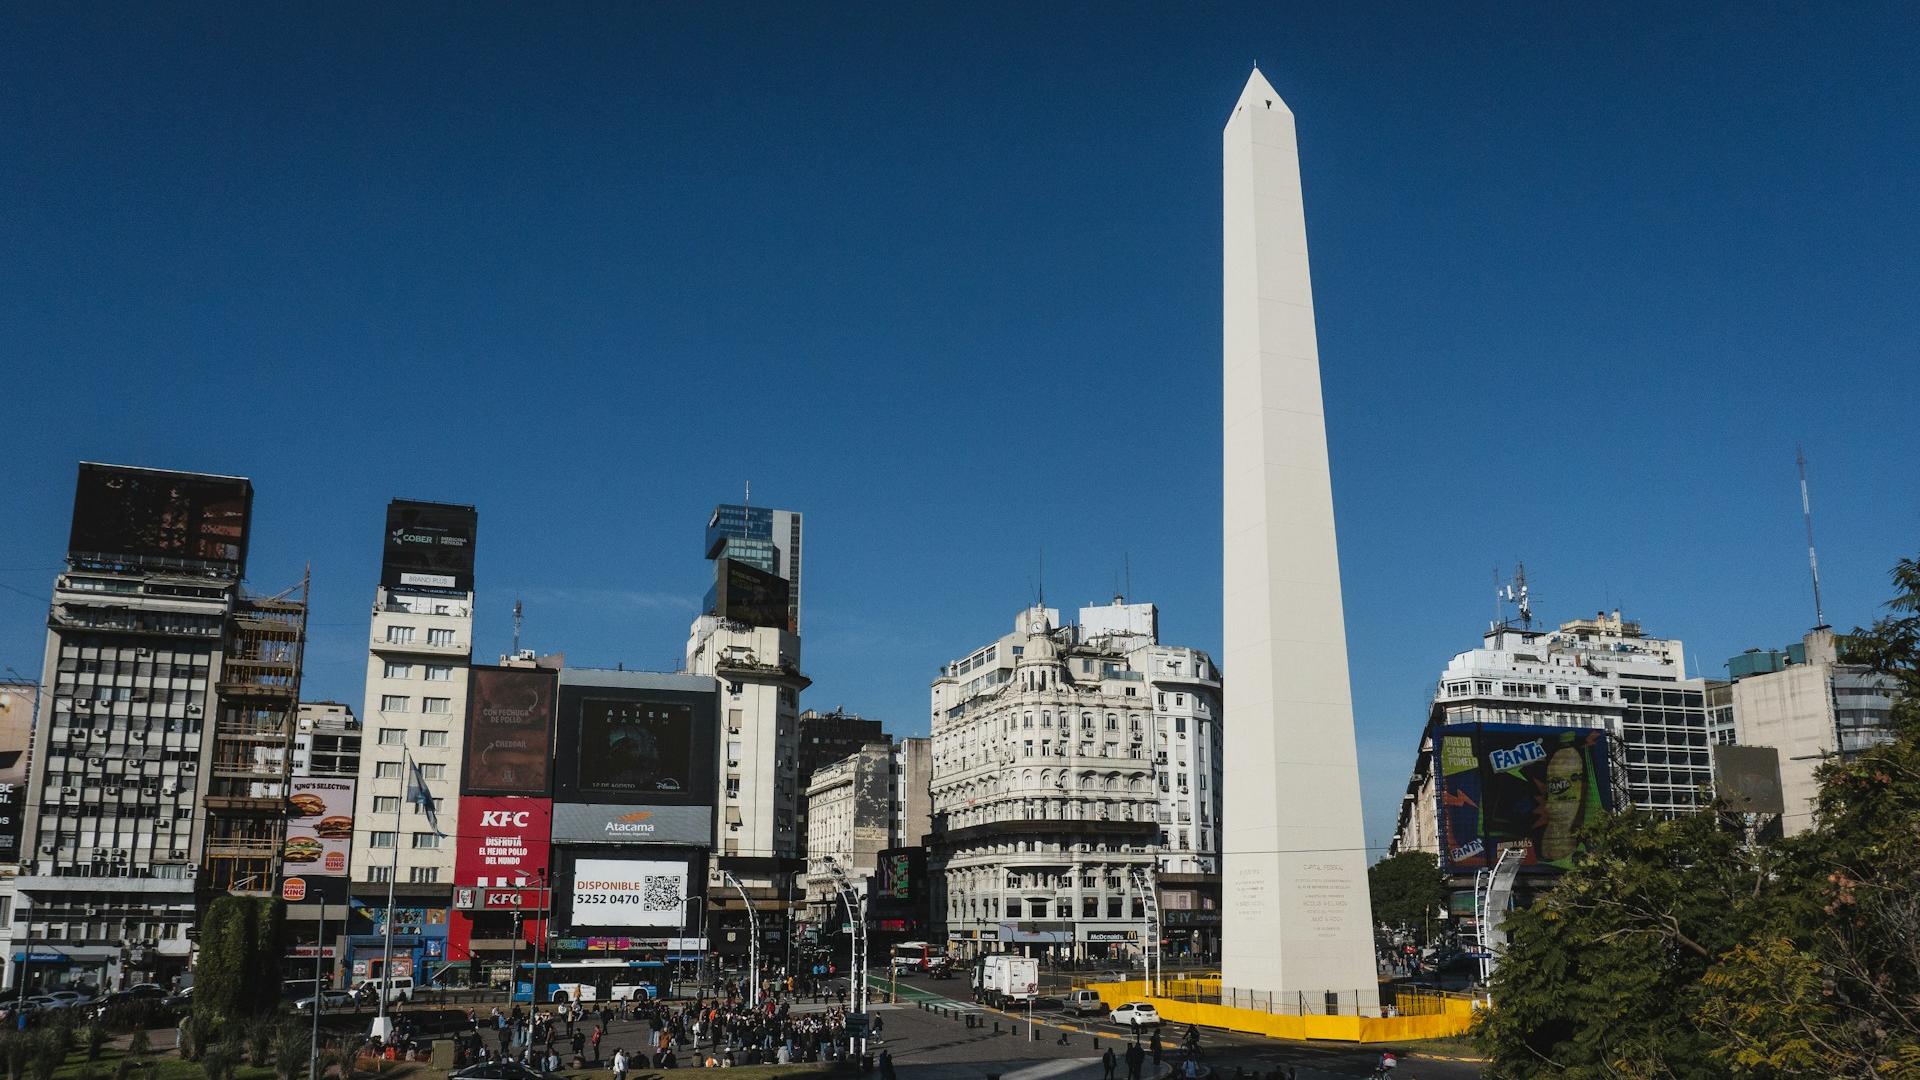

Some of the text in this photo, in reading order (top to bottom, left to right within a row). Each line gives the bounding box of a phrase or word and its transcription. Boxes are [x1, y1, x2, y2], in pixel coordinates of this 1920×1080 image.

[402, 534, 432, 544] COBER
[607, 709, 668, 718] ALIEN
[1444, 736, 1471, 746] NUEVO
[1447, 746, 1472, 756] SABOR
[1493, 742, 1544, 770] FANTA
[1448, 756, 1478, 767] POMELO
[480, 811, 530, 827] KFC
[605, 822, 654, 832] Atacama
[1452, 841, 1483, 860] FANTA
[577, 881, 640, 891] DISPONIBLE
[488, 894, 522, 904] KFC
[577, 894, 639, 904] 5252 0470
